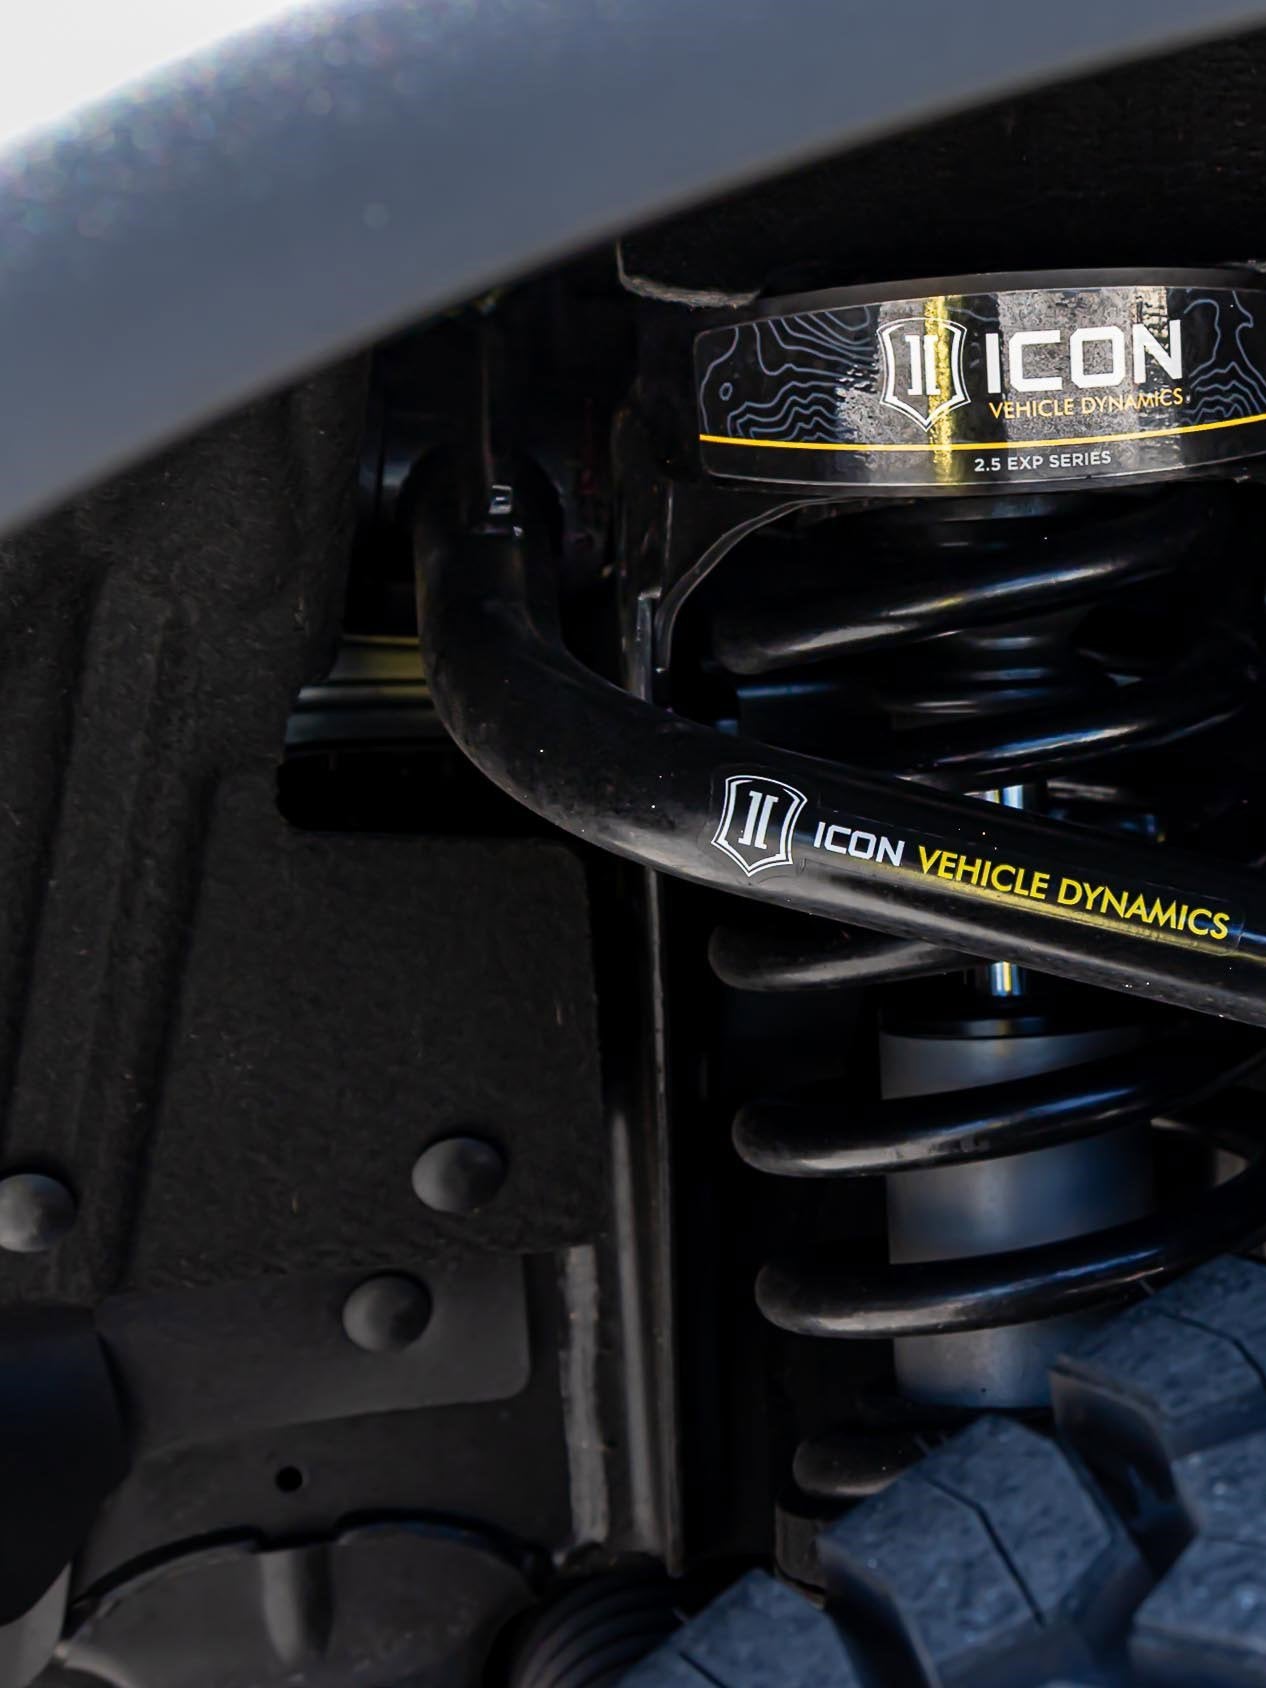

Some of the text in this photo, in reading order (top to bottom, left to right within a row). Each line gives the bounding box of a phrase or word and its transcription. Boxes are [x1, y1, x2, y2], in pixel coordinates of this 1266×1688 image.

[985, 319, 1183, 394] ICON
[988, 387, 1184, 420] VEHICLE DYNAMICS
[974, 450, 1112, 472] 2.5 EXP SERIES
[813, 821, 1230, 940] ICON VEHICLE DYNAMICS
